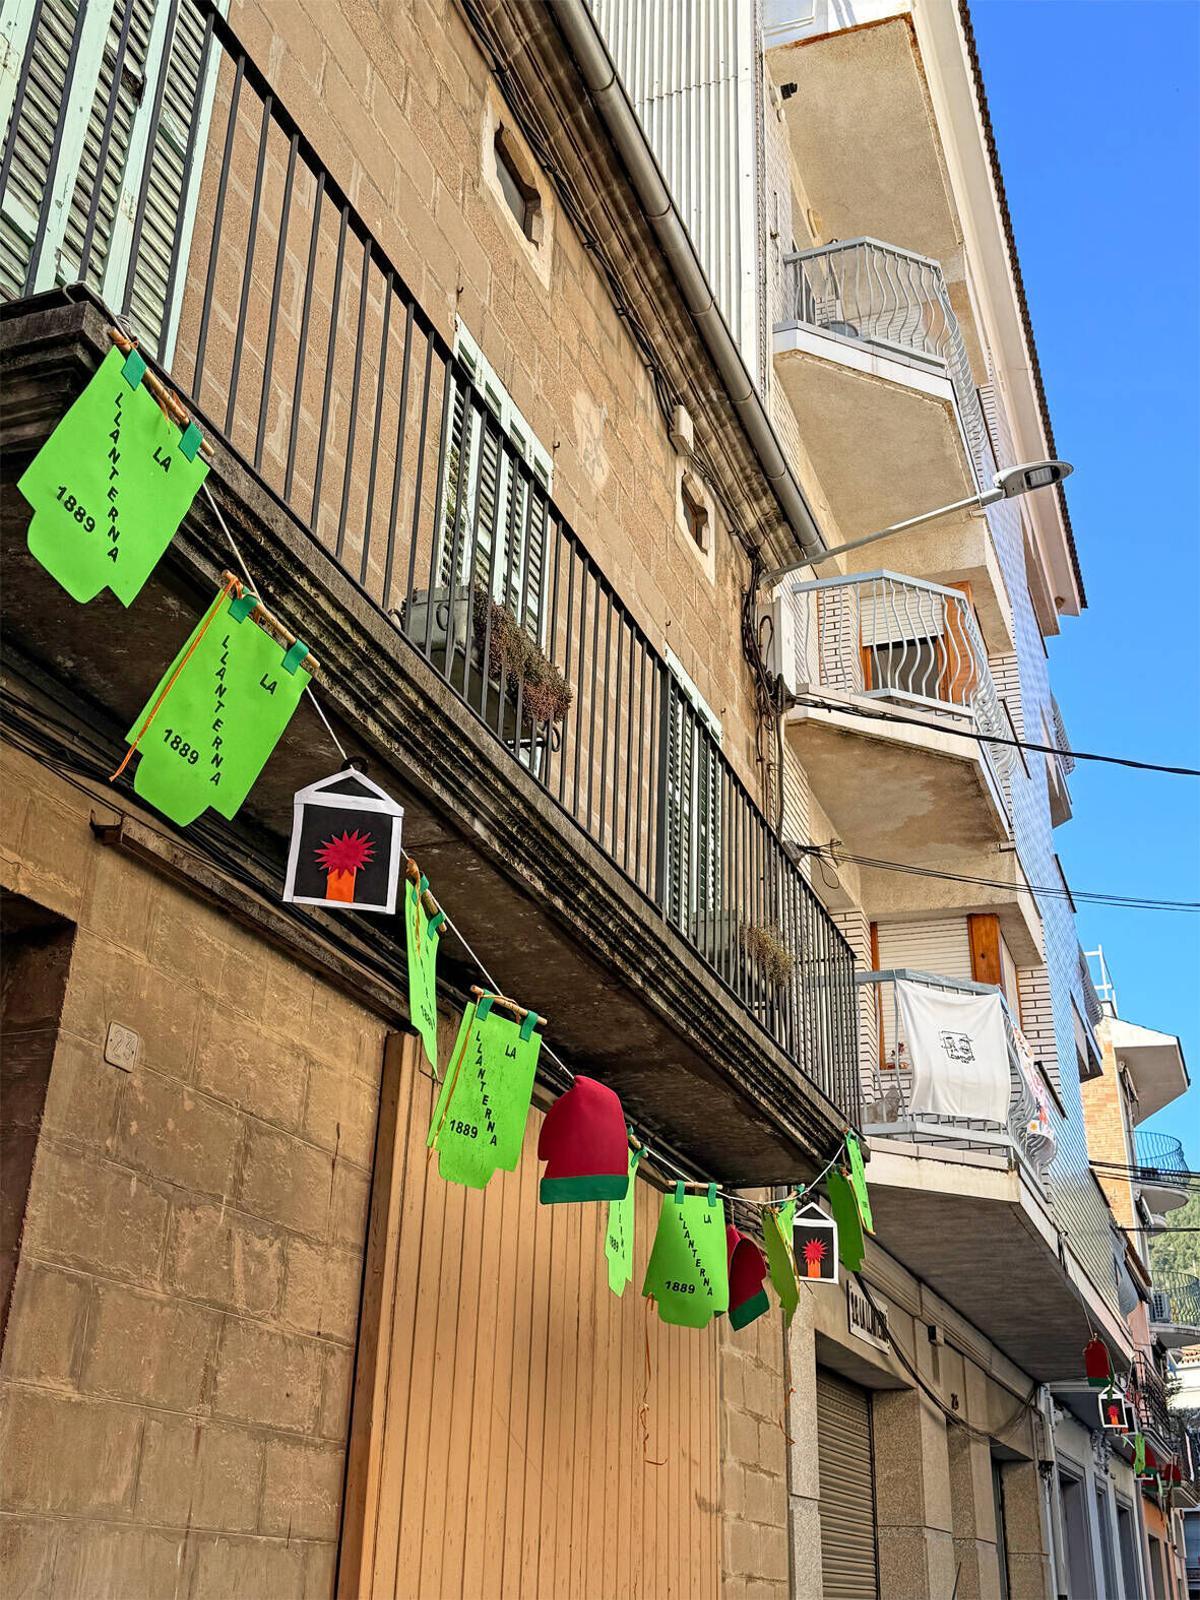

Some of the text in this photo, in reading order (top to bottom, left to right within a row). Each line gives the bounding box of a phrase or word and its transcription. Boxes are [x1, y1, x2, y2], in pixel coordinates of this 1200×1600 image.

[153, 446, 171, 473] LA
[108, 392, 123, 563] LLANTERNA
[56, 486, 96, 533] 1889
[260, 673, 278, 694] LA
[210, 635, 230, 786] LLANTERNA
[163, 729, 199, 765] 1889
[505, 1045, 517, 1060] LA
[475, 1031, 497, 1146] LLANTERNA
[450, 1119, 478, 1139] 1889
[703, 1214, 712, 1224] LA
[678, 1212, 713, 1296] LLANTERNA
[664, 1280, 696, 1295] 1889
